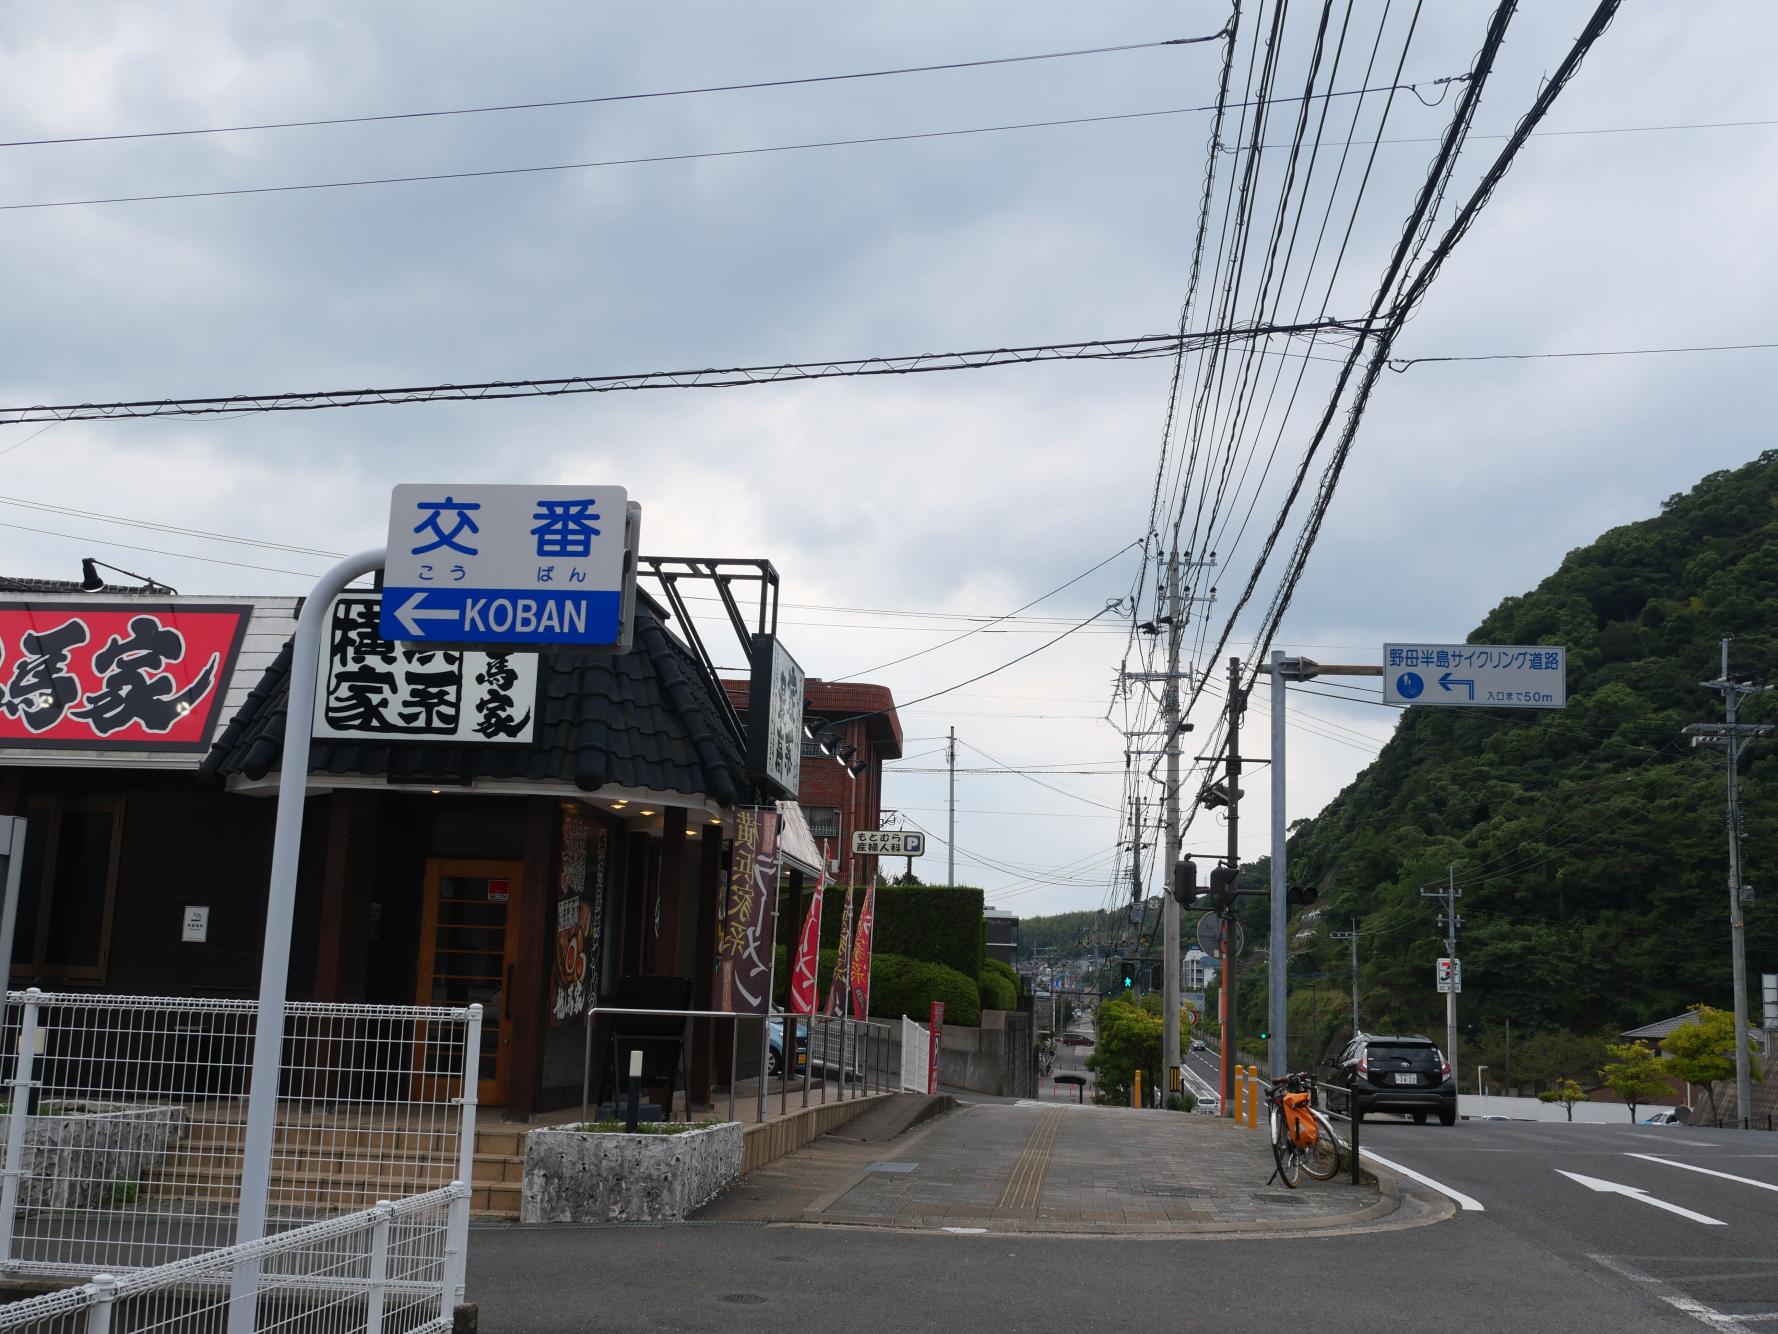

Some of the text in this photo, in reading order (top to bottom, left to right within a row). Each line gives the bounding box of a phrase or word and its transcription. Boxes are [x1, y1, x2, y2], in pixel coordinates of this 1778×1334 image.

[411, 496, 601, 557] 交番
[463, 598, 588, 633] KOBAN
[1389, 648, 1559, 670] 野母半島サイクリング道路
[0, 614, 220, 737] 馬家
[856, 842, 901, 853] 産婦人科
[857, 833, 901, 842] もとむら
[906, 836, 919, 851] P
